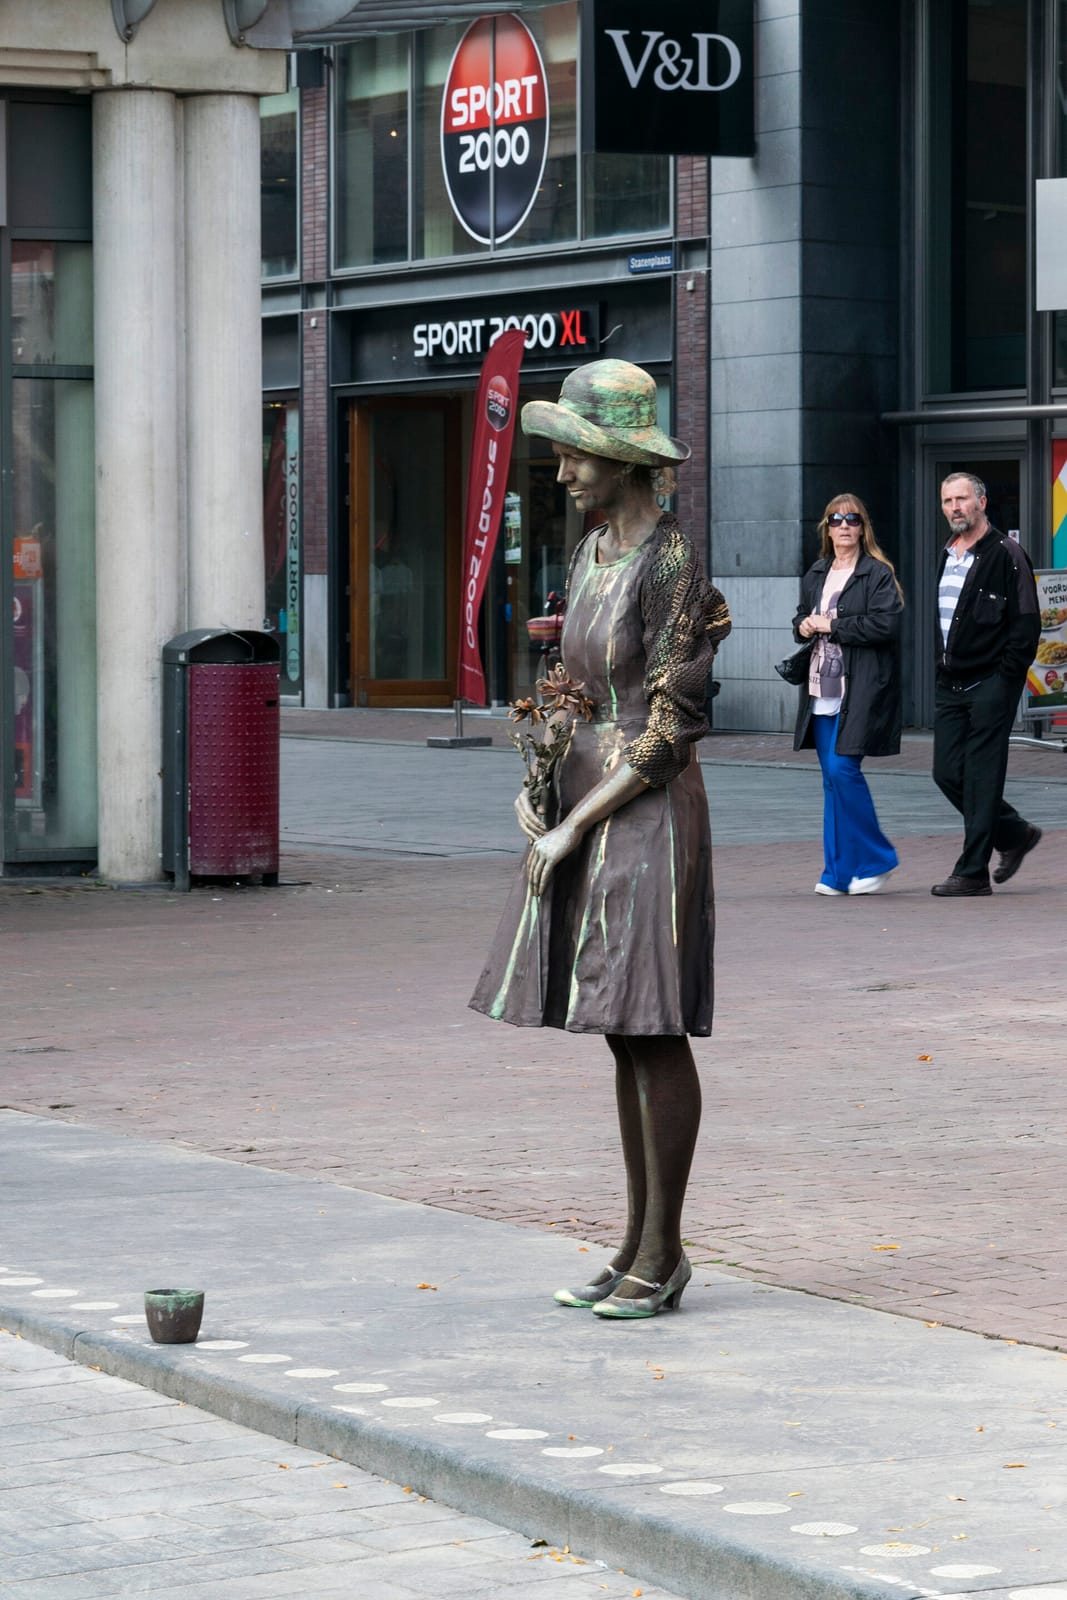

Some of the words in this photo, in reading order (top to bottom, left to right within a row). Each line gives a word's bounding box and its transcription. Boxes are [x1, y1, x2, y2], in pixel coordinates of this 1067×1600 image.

[605, 29, 742, 92] V&D
[451, 75, 538, 127] SPORT
[459, 126, 530, 174] 2000
[413, 318, 486, 357] SPORT
[560, 309, 587, 346] XL
[289, 451, 298, 476] XL
[289, 483, 298, 551] 2000
[475, 439, 498, 555] SPORT
[466, 555, 482, 649] 2000
